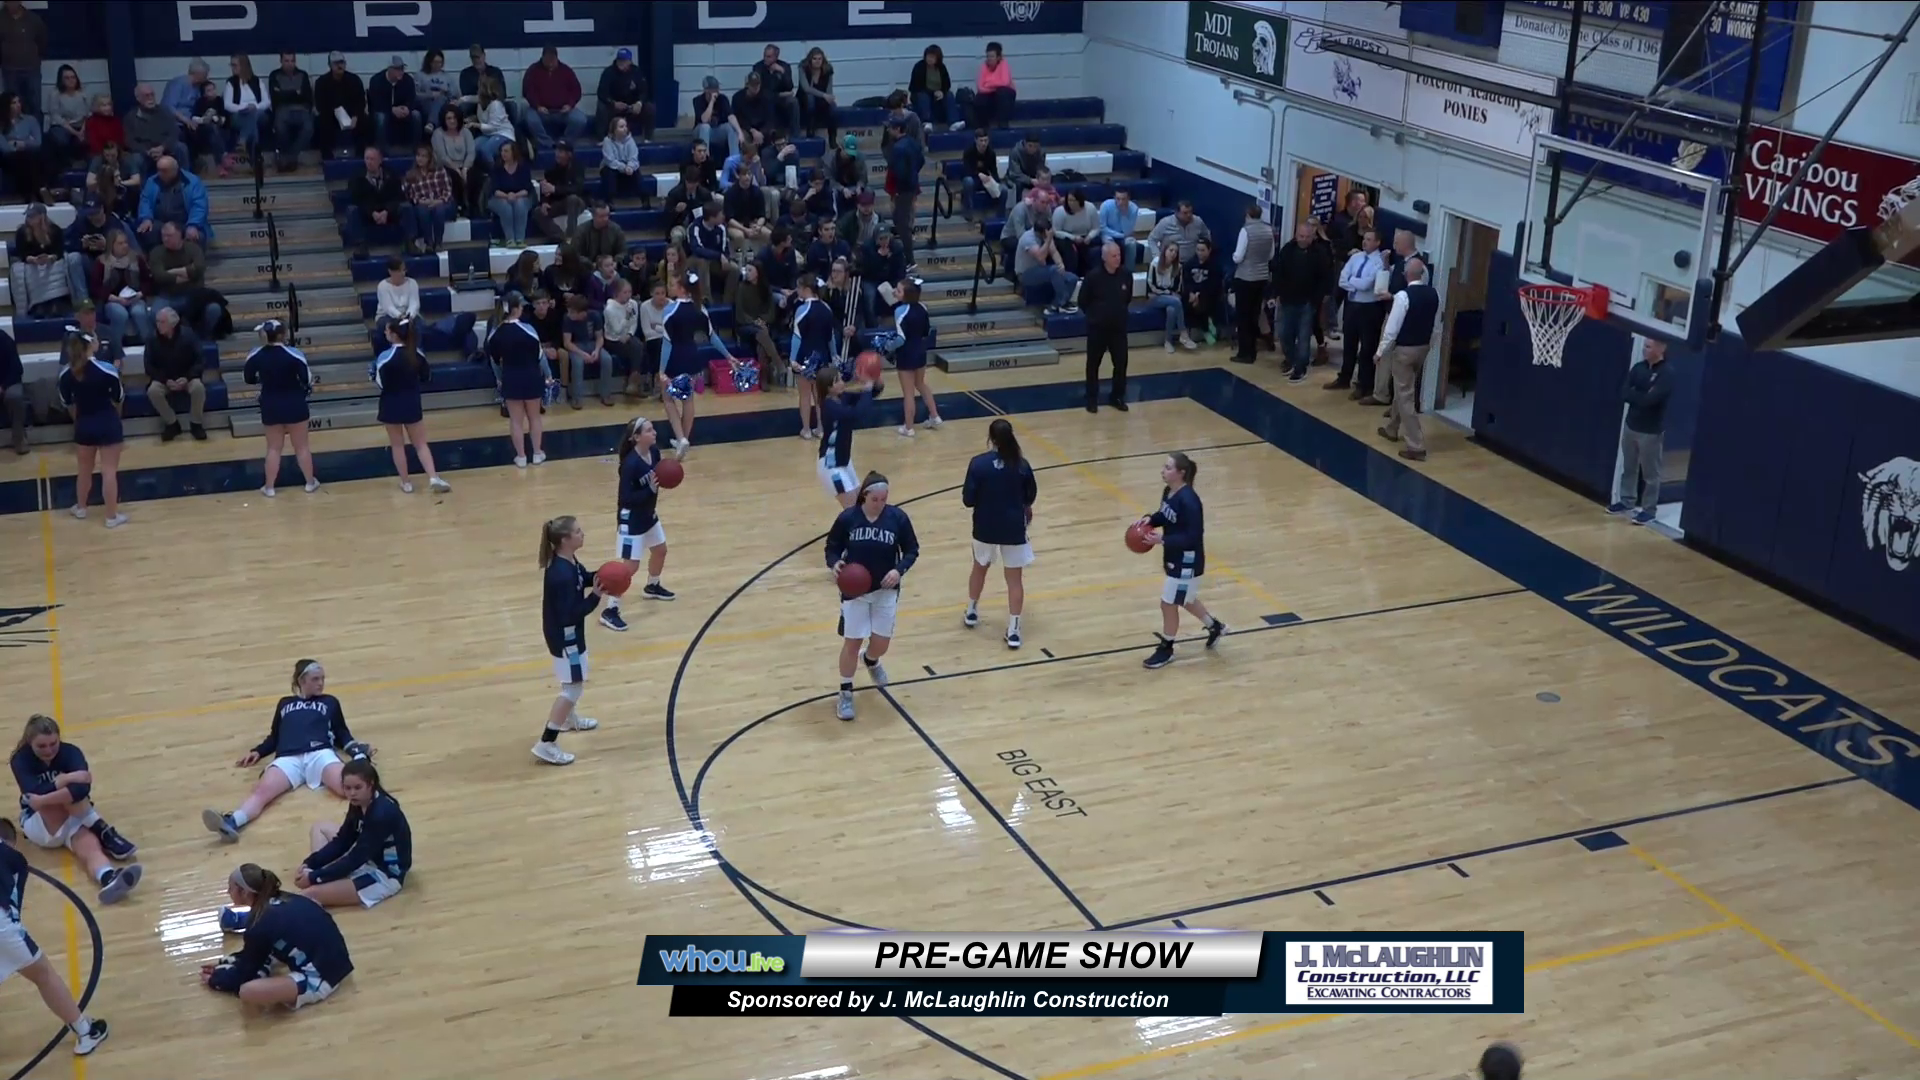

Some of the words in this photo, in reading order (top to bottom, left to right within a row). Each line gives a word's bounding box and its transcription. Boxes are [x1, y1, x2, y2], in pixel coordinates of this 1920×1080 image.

[1204, 12, 1233, 35] MDI
[1633, 6, 1650, 23] 430
[1709, 15, 1722, 34] 30
[1347, 36, 1382, 52] BAPST
[1515, 15, 1556, 36] Donated
[1558, 27, 1569, 40] by
[1592, 30, 1620, 48] Class
[1622, 37, 1635, 51] of
[1638, 39, 1660, 56] 196
[1195, 33, 1240, 61] TROJANS
[1443, 98, 1488, 124] PONIES
[1750, 139, 1858, 193] Caribou
[1744, 173, 1858, 228] VIKINGS
[286, 263, 293, 272] 5
[927, 257, 949, 265] ROW
[946, 289, 967, 297] ROW
[967, 322, 989, 331] ROW
[990, 321, 996, 330] 2
[989, 359, 1013, 368] ROW
[849, 526, 896, 546] WILDCATS
[1563, 583, 1920, 766] WILDCATS
[280, 700, 329, 719] WILDCATS
[996, 749, 1042, 776] BIG
[1024, 777, 1088, 818] EAST
